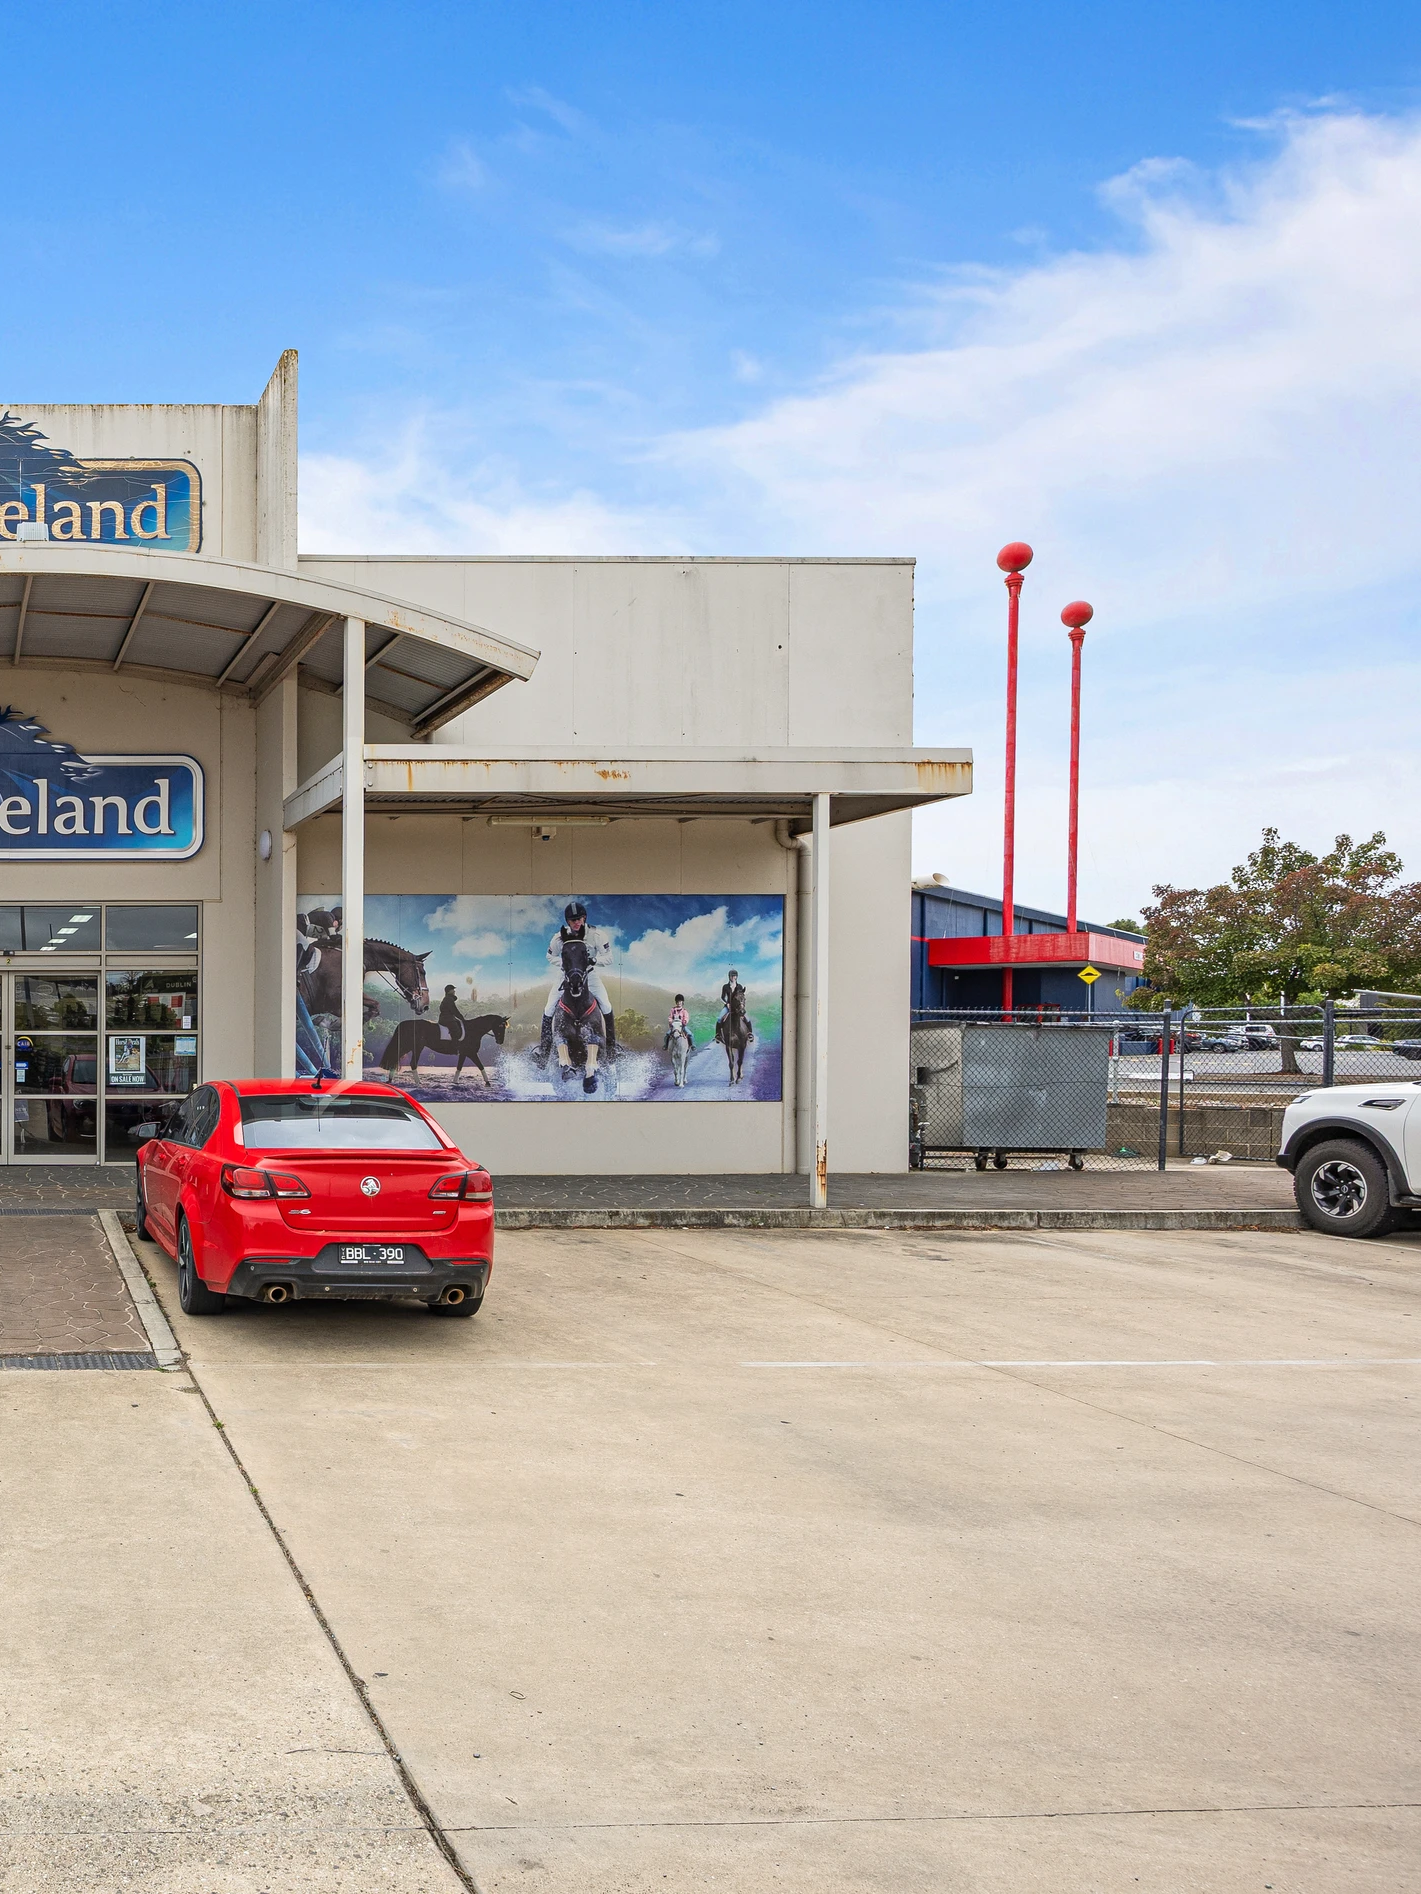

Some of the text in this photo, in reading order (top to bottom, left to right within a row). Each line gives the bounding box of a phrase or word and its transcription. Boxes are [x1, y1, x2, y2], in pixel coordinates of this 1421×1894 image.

[111, 1075, 145, 1083] ON SALE NOW
